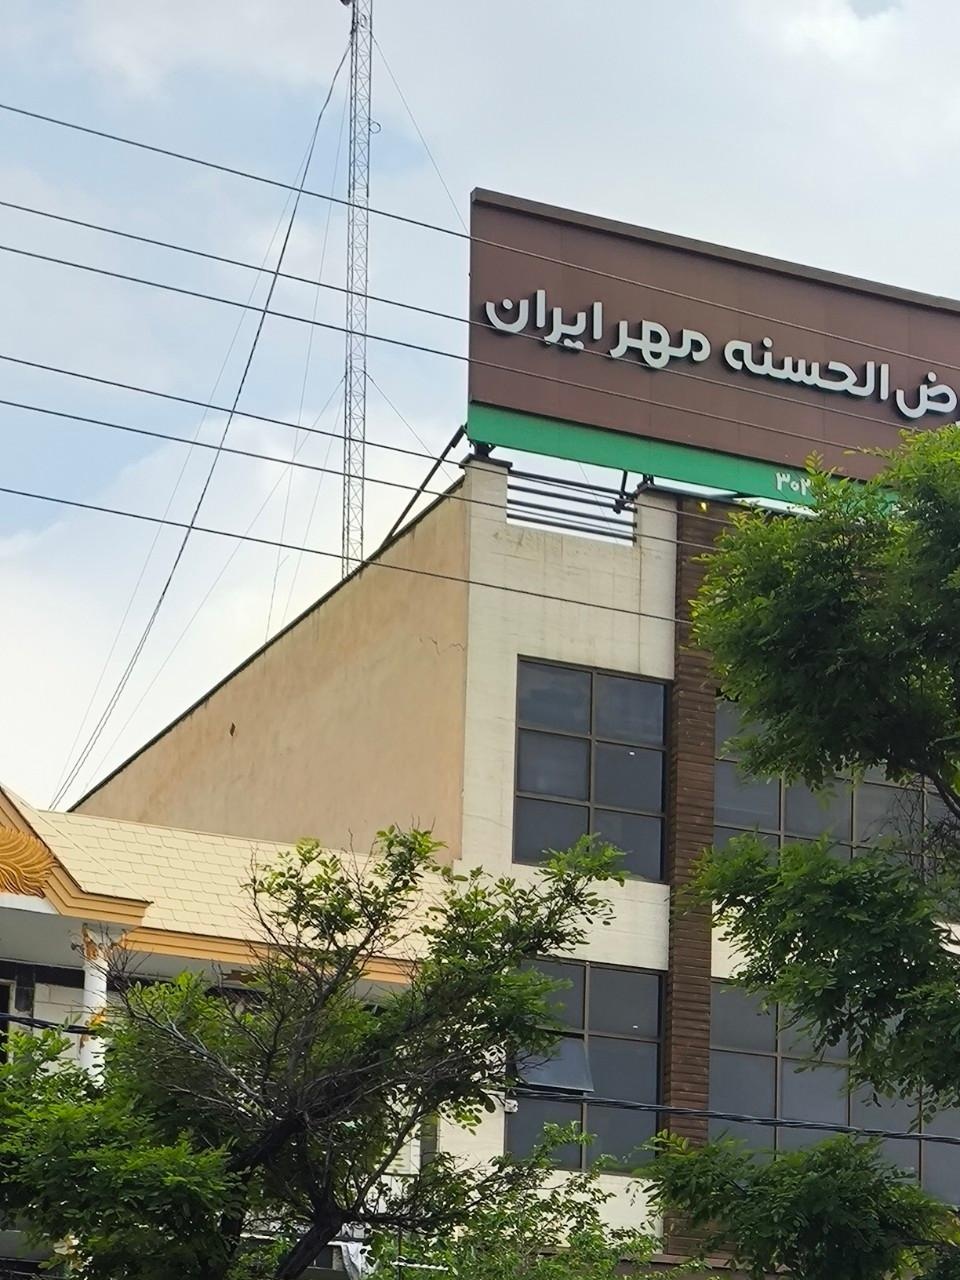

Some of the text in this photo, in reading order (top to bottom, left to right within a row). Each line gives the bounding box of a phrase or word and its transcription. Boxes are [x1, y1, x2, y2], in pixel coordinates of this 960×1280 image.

[485, 289, 603, 351] ایران
[609, 319, 711, 370] مهر
[723, 337, 889, 401] الحسنه
